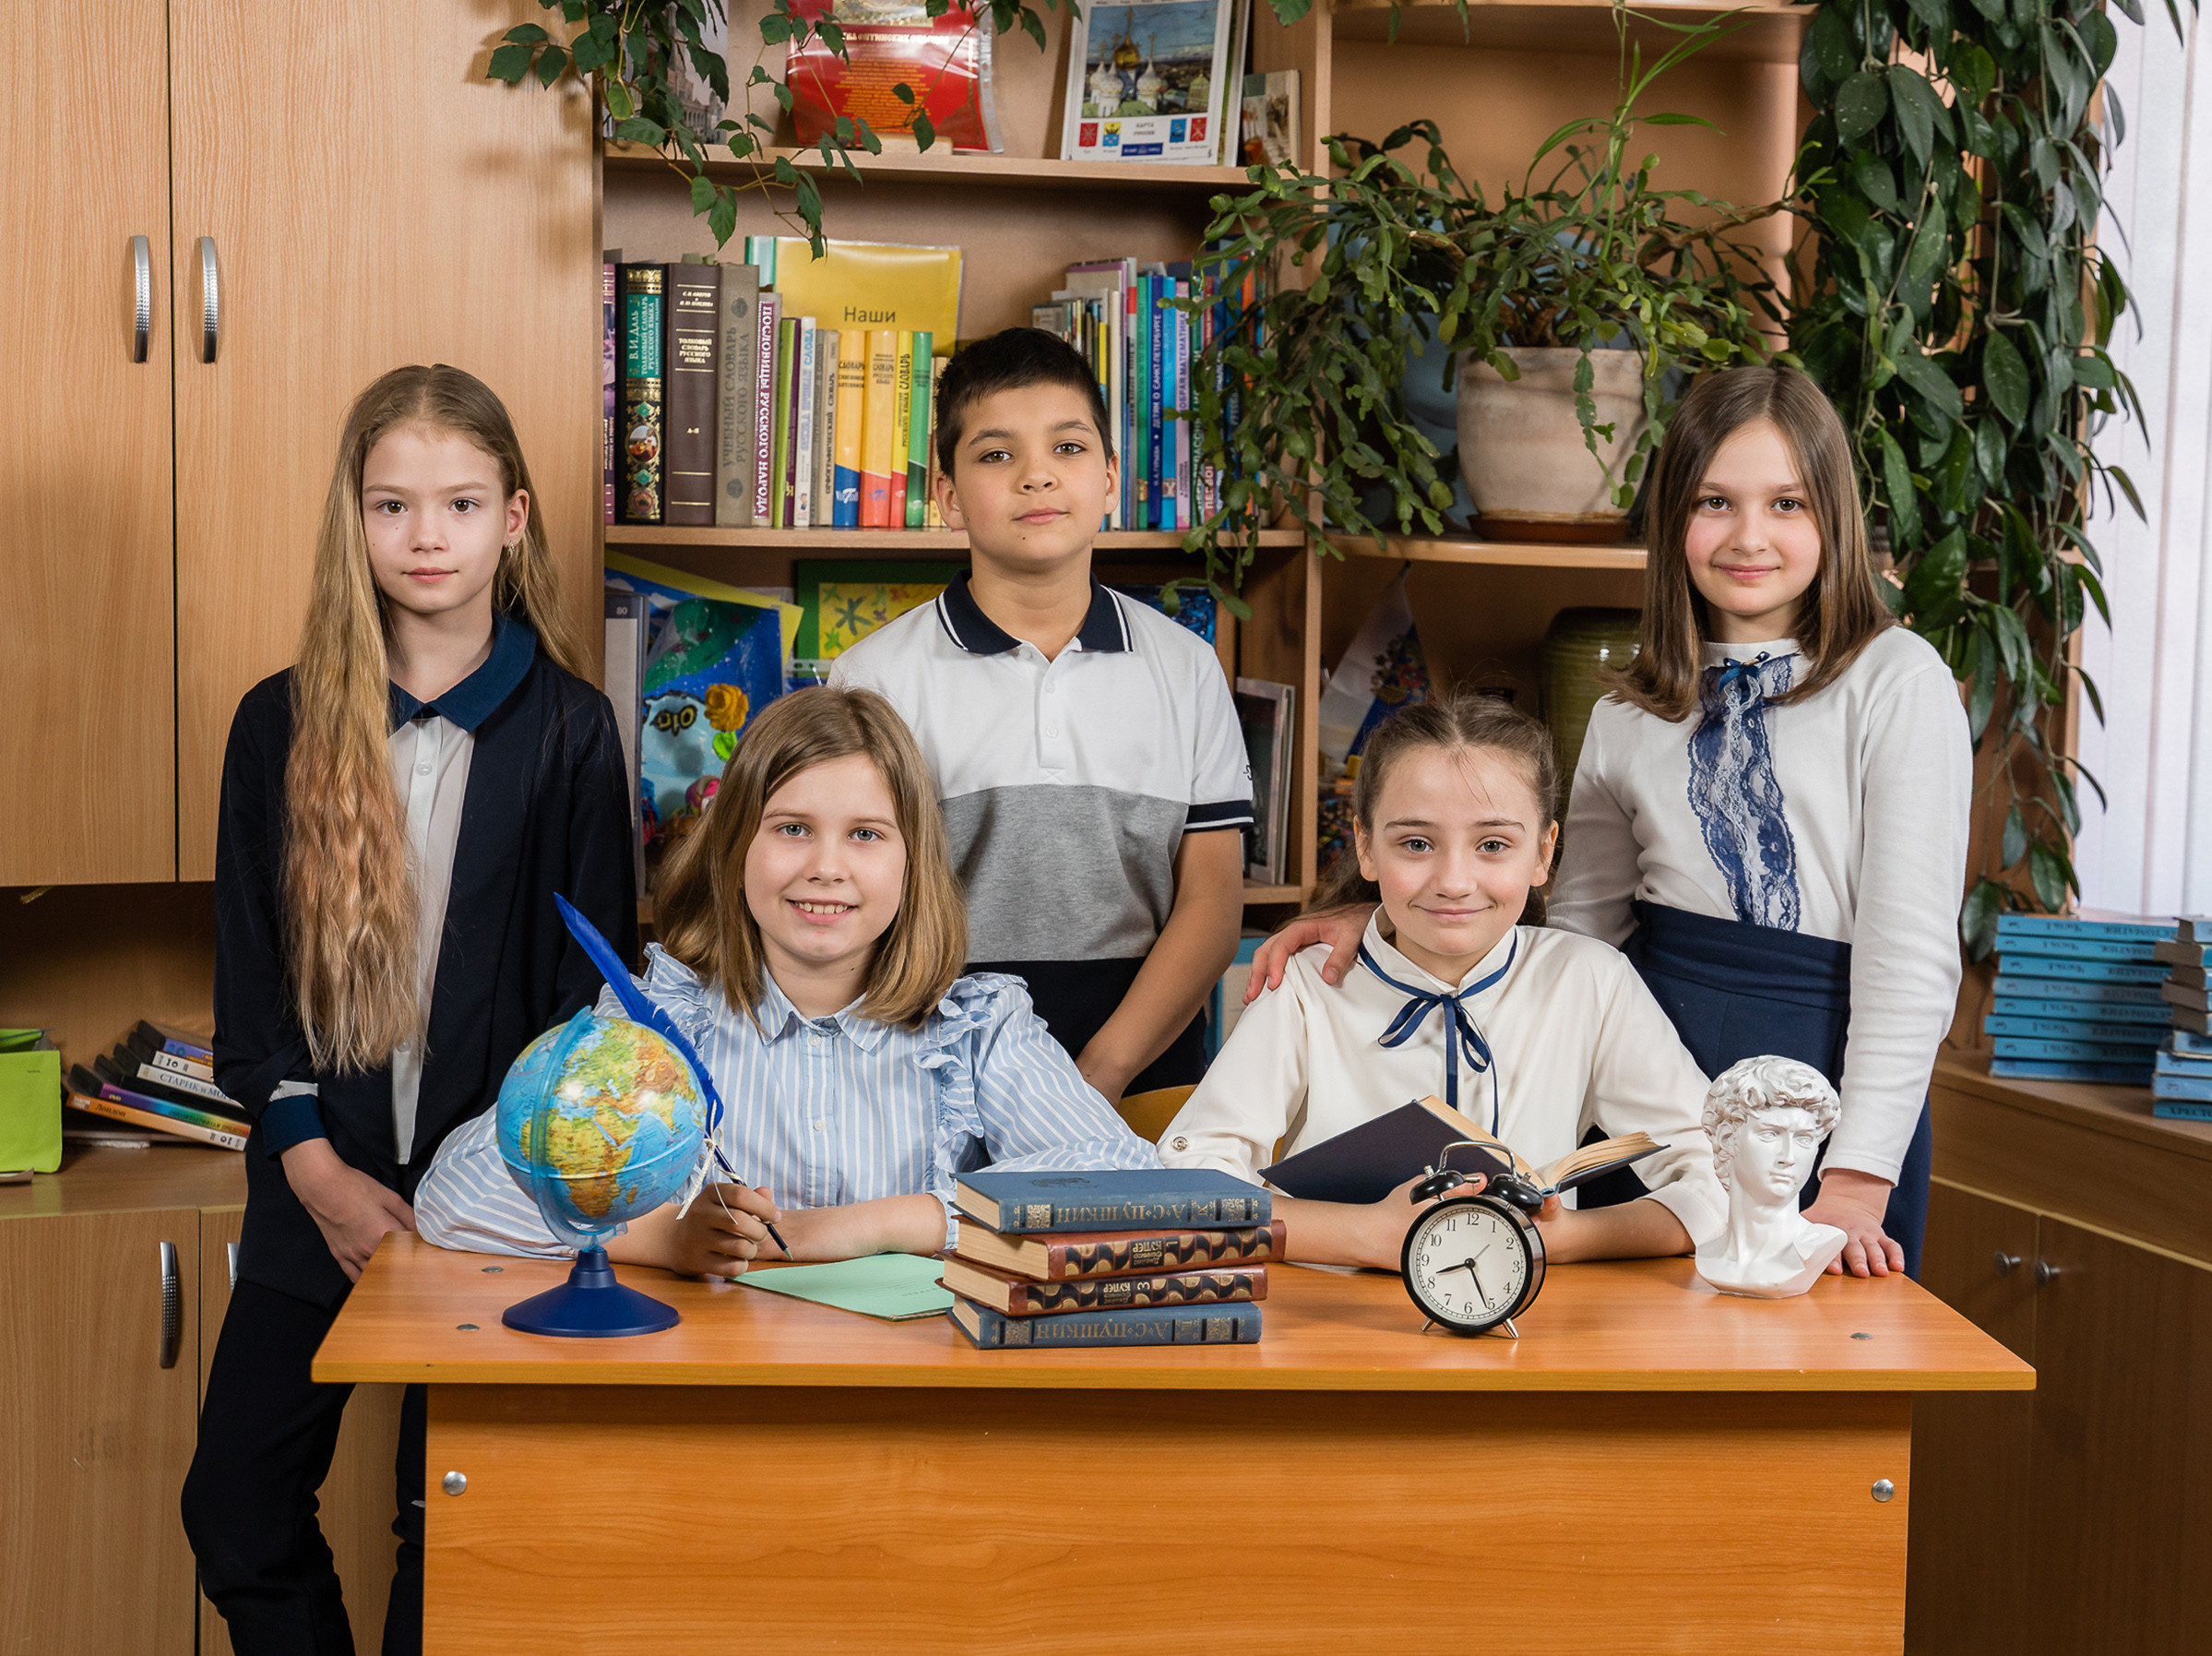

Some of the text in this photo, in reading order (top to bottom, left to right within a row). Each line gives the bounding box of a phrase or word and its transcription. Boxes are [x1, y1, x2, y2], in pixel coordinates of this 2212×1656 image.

[844, 305, 896, 323] Наши
[678, 338, 712, 346] ТОЛКОВЫЙ
[803, 328, 814, 366] СЛОВА
[1178, 313, 1187, 375] МАТЕМАТИКА
[641, 331, 649, 375] ТОЛКОВЫЙ
[1152, 315, 1161, 390] САНКТ-ПЕТЕРБУРГЕ
[838, 362, 865, 370] СЛОВАРЬ
[899, 353, 910, 389] СЛОВАРЬ
[722, 327, 737, 467] УЧЕБНЫЙ СЛОВАРЬ
[736, 333, 750, 462] РУССКОГО ЯЗЫКА
[755, 305, 773, 514] ПОСЛОВИЦЫ РУССКОГО НАРОДА
[1152, 402, 1160, 428] ДЕТЯМ
[824, 372, 835, 494] ОРФОГРАФИЧЕСКИЙ СЛОВАРЬ
[616, 607, 628, 615] 80
[160, 1073, 200, 1091] СТАРИК
[1446, 1219, 1457, 1231] 11
[1467, 1213, 1480, 1225] 12
[1492, 1221, 1496, 1233] 1
[1430, 1234, 1442, 1246] 10
[1505, 1239, 1514, 1250] 2
[1132, 1240, 1162, 1253] КУПЕР
[1421, 1254, 1430, 1267] 9
[1512, 1260, 1520, 1273] 3
[1102, 1282, 1132, 1293] КУПЕР
[1136, 1281, 1150, 1290] 3
[1427, 1277, 1435, 1289] 8
[1503, 1282, 1512, 1293] 4
[1444, 1293, 1452, 1305] 7
[1487, 1298, 1495, 1310] 5
[1464, 1302, 1472, 1314] 6
